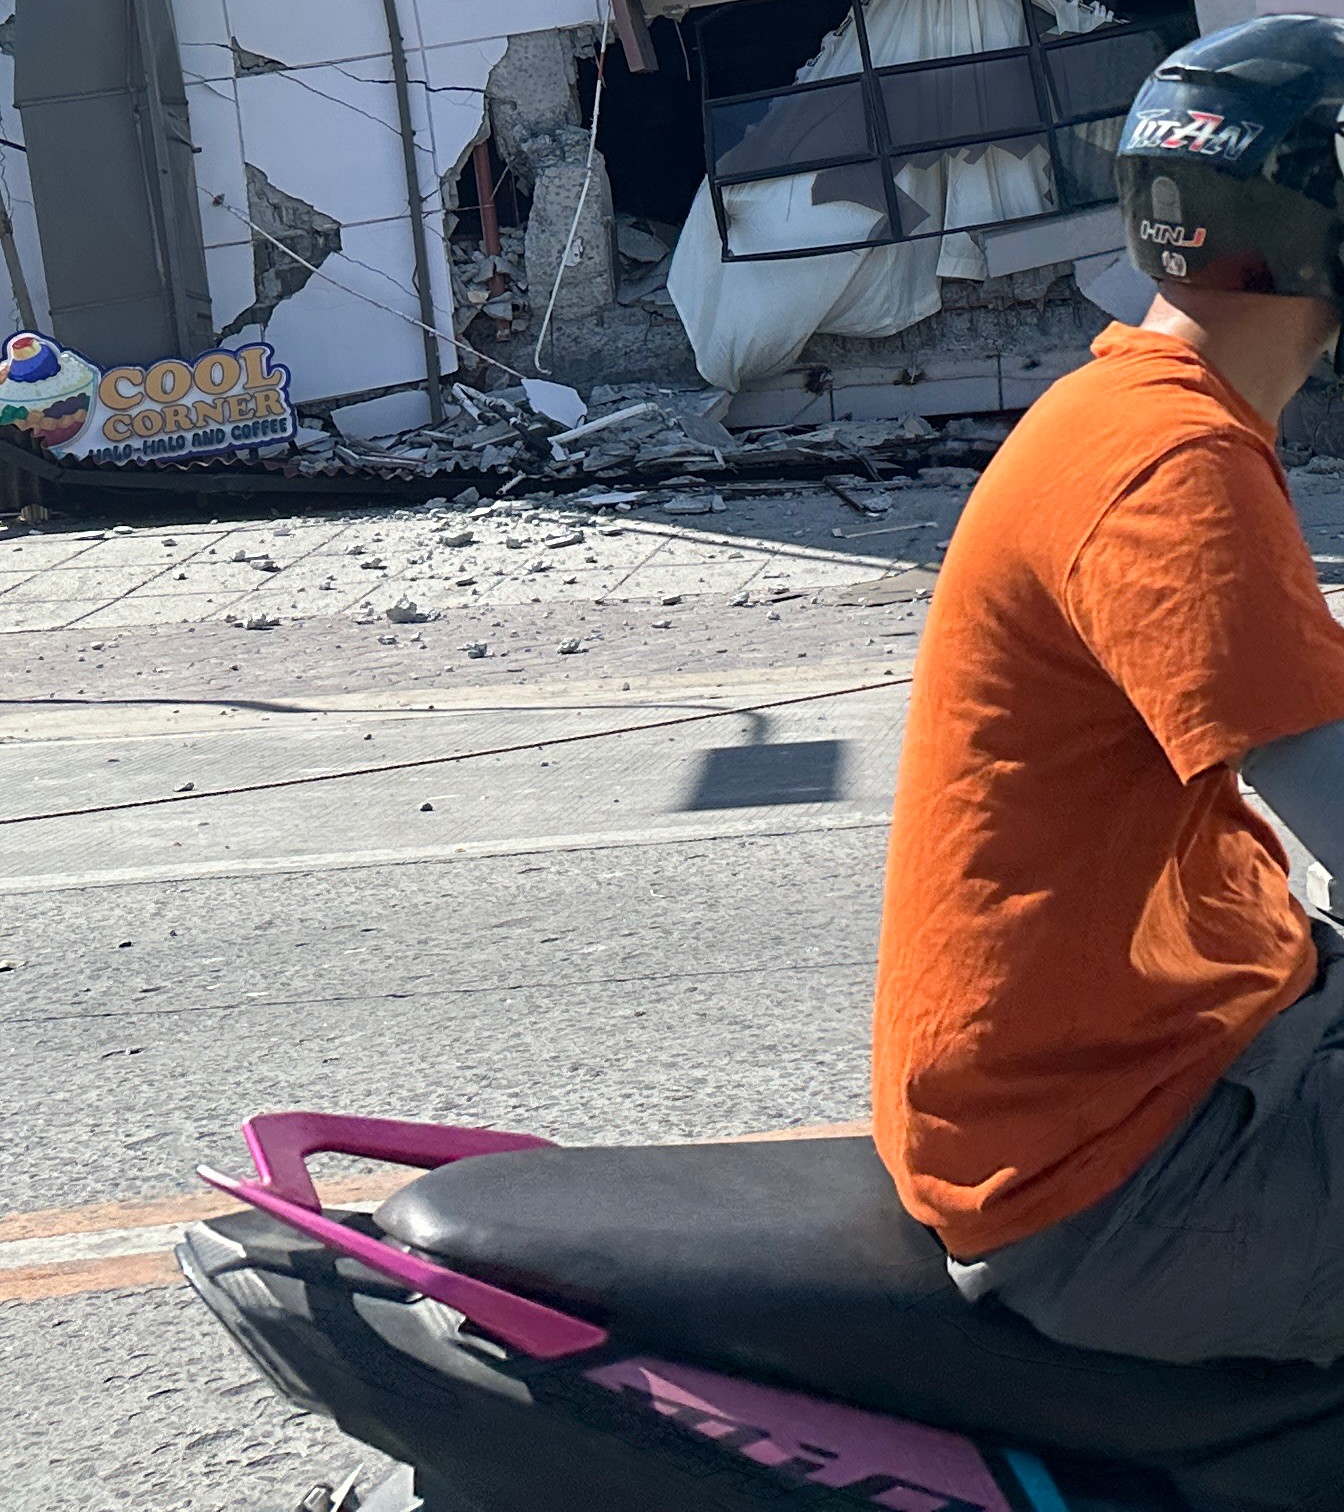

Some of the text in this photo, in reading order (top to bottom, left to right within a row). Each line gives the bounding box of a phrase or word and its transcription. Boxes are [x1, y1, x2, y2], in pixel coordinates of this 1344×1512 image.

[1126, 108, 1264, 161] TITAN
[98, 346, 283, 410] COOL
[102, 389, 286, 442] CORNER
[191, 428, 226, 447] AND
[231, 417, 287, 439] COFFEE
